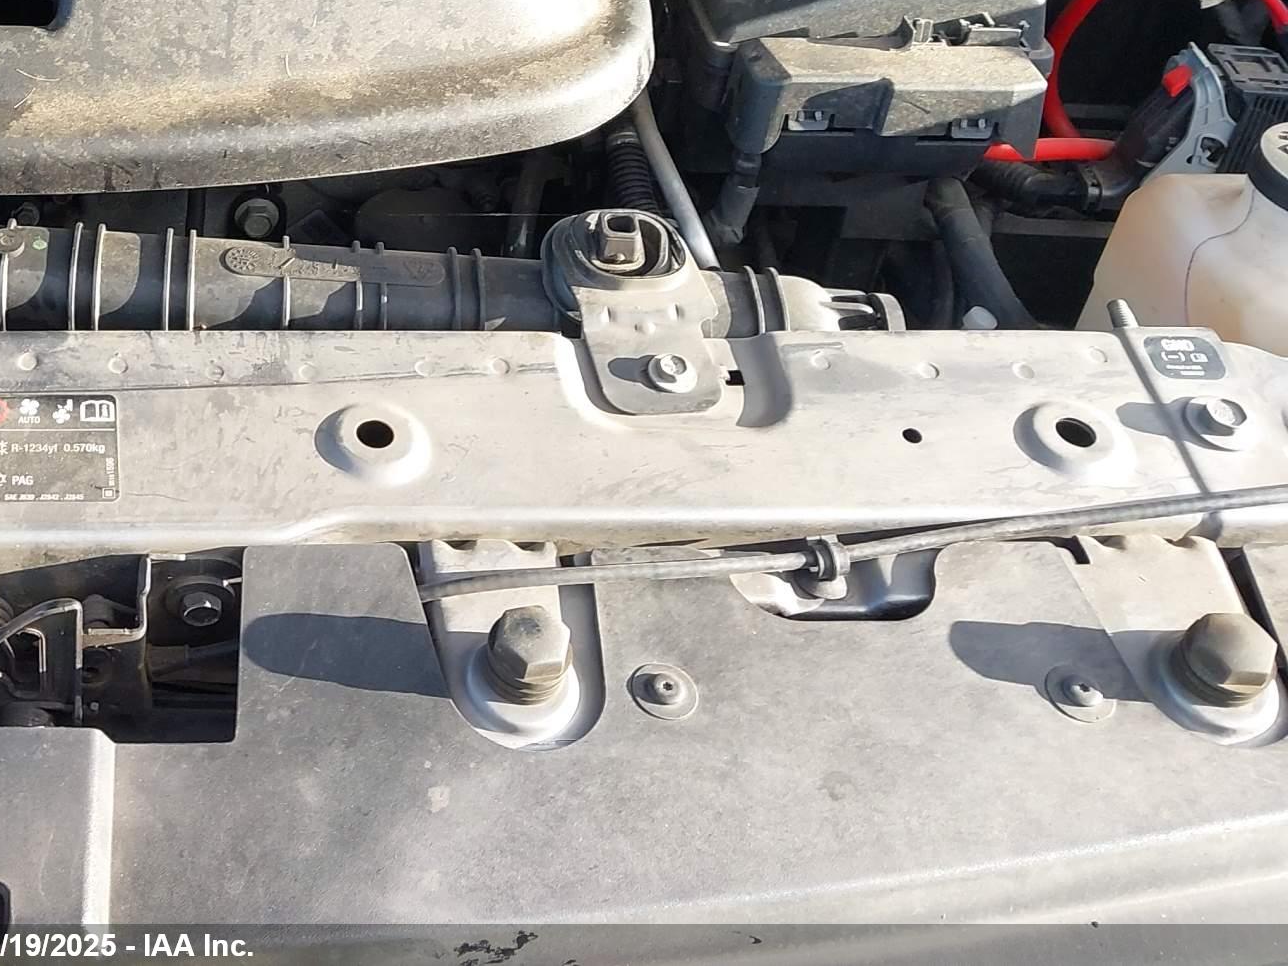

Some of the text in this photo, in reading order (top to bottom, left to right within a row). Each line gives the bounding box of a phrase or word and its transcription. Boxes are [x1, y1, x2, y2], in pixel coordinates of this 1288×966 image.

[18, 416, 41, 424] AUTO
[11, 443, 106, 454] R-1234yf 0.570kg
[11, 474, 34, 485] PAG
